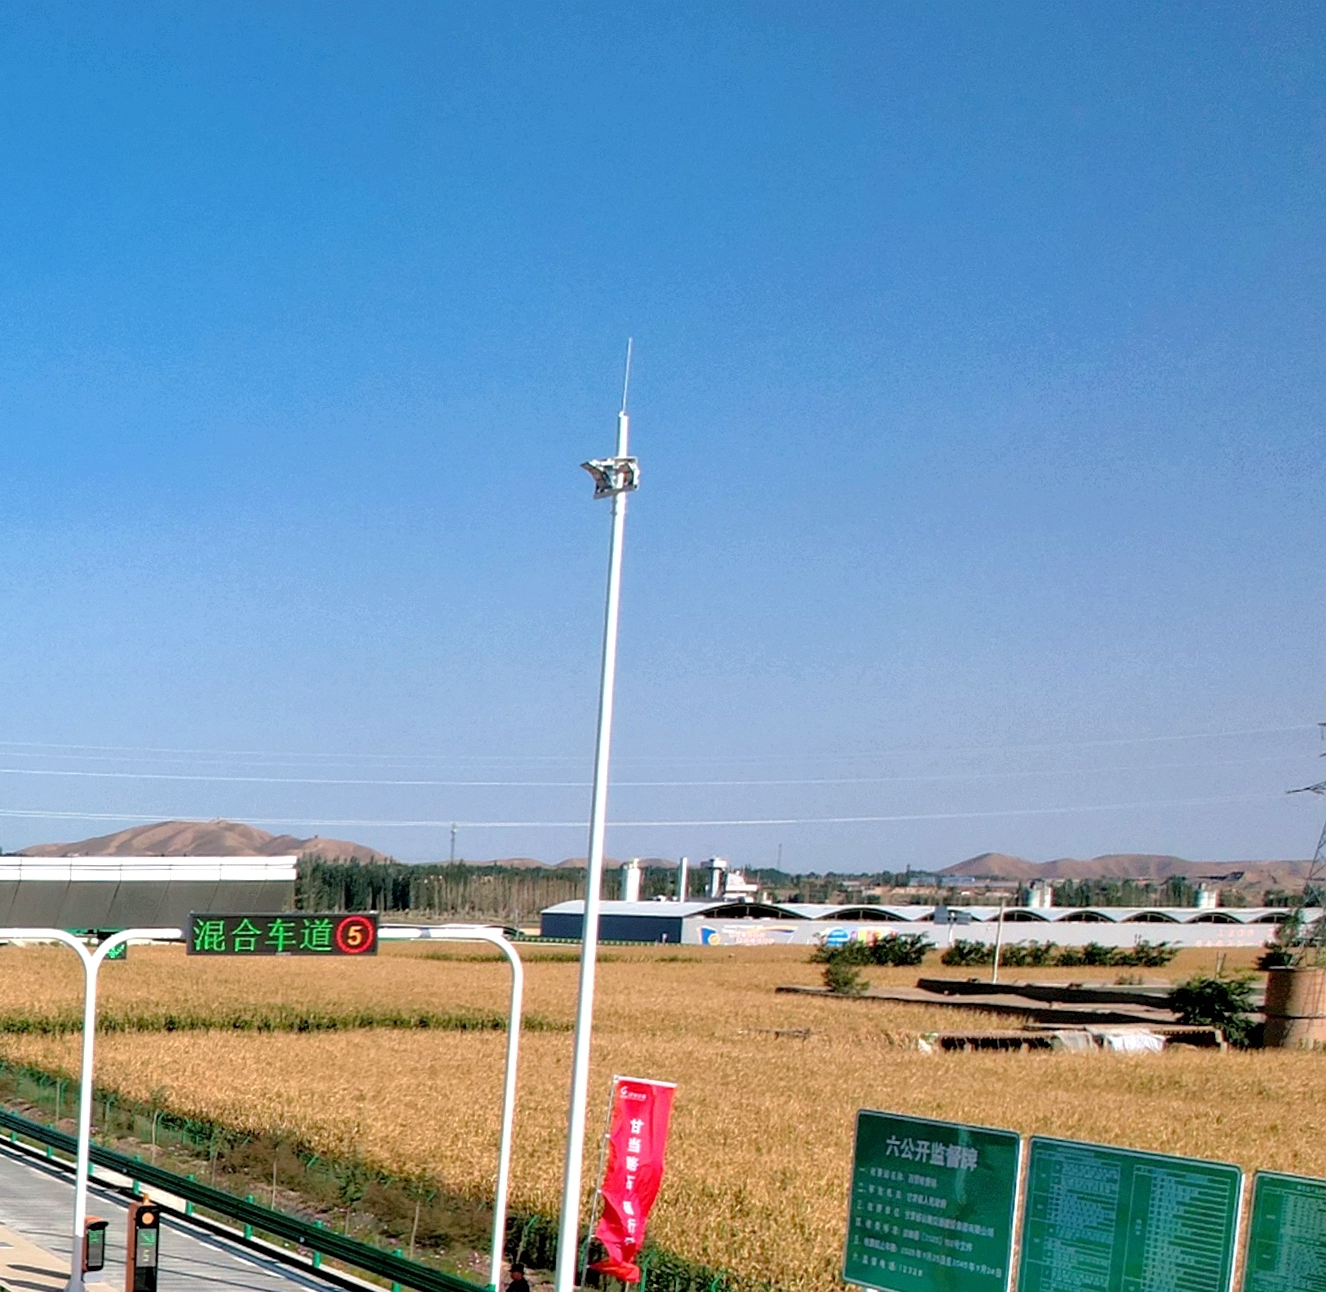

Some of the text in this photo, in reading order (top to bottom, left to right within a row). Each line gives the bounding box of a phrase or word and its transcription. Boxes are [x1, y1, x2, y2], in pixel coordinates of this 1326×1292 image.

[193, 917, 363, 952] 混合车道 5
[886, 1135, 978, 1171] 六公开监督牌
